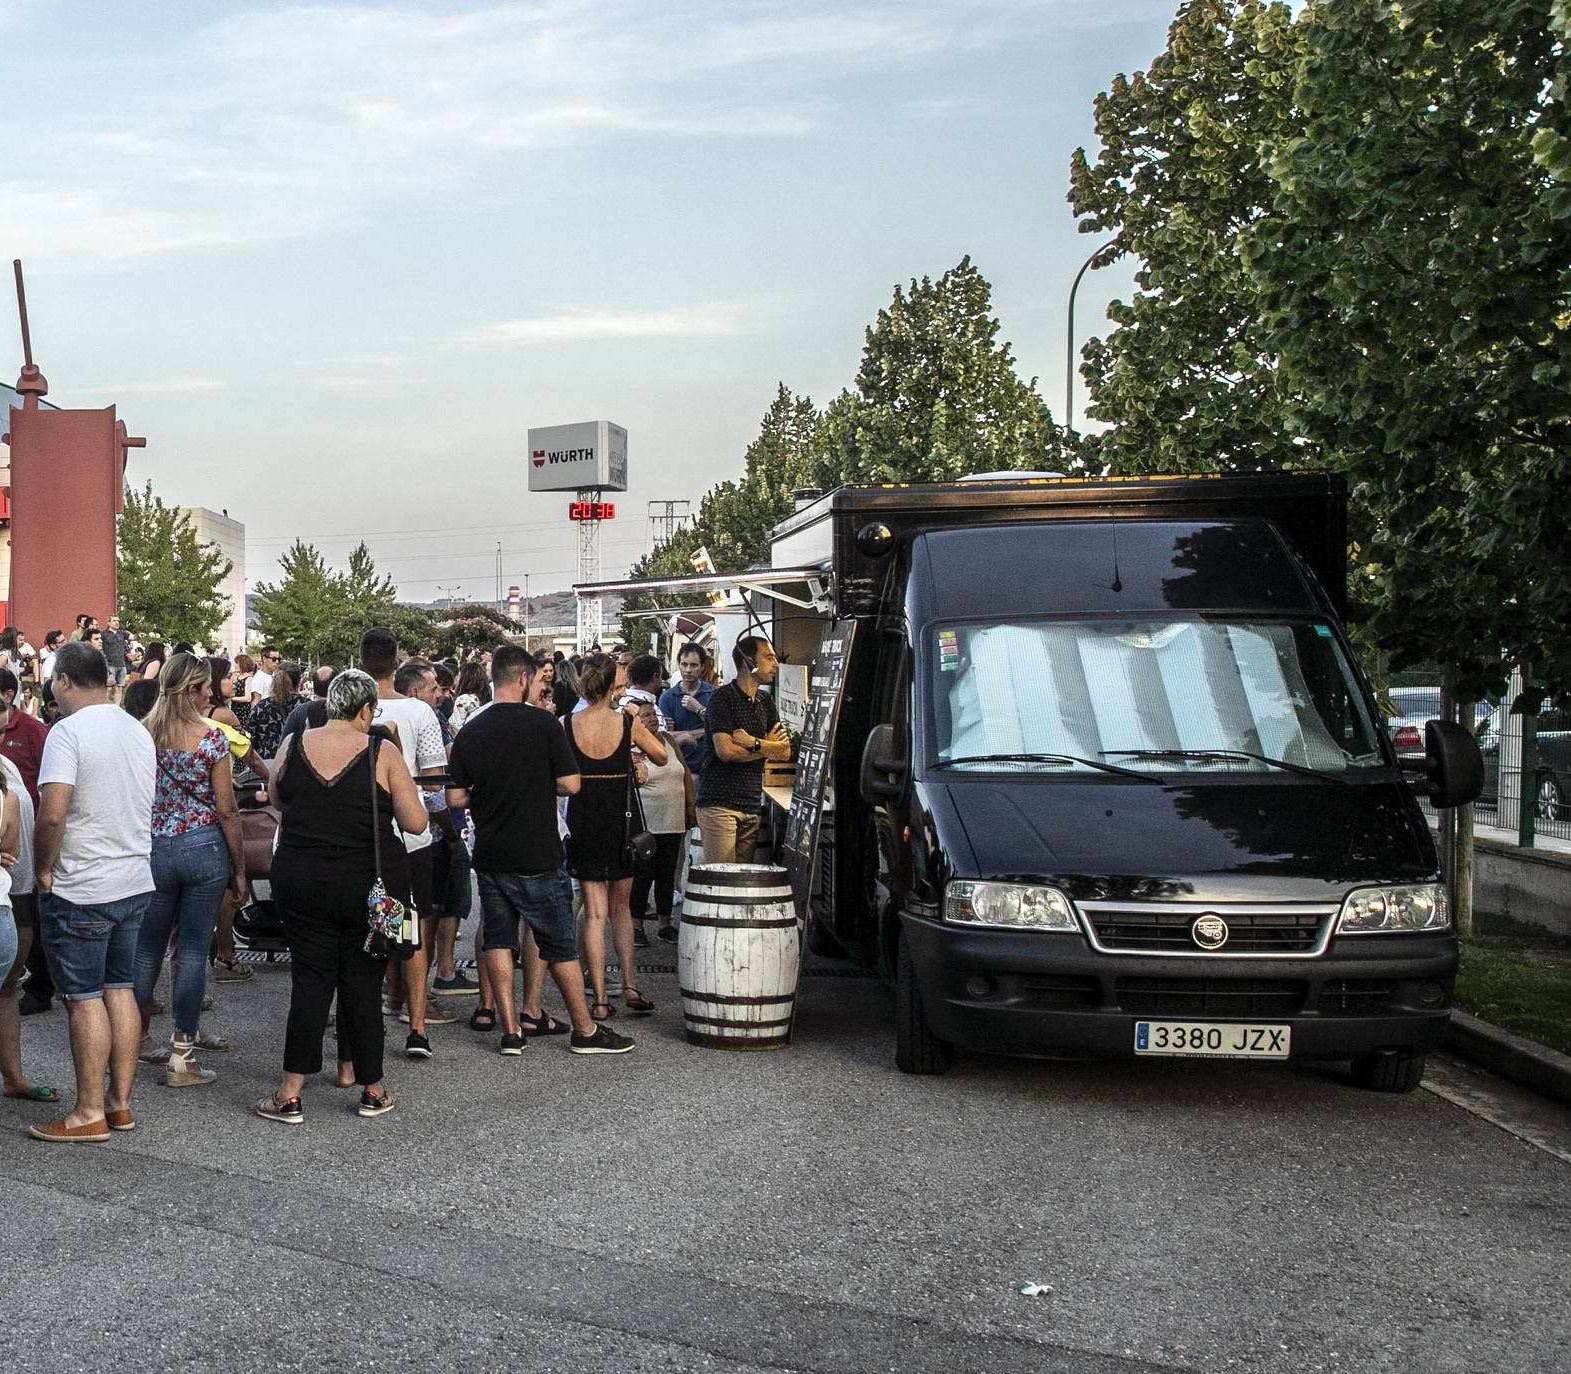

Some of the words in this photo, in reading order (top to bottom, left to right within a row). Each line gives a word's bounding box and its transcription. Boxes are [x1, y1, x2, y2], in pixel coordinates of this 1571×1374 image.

[548, 447, 593, 464] WÜRTH
[1155, 1027, 1222, 1050] 3380
[1233, 1029, 1283, 1051] JZX
